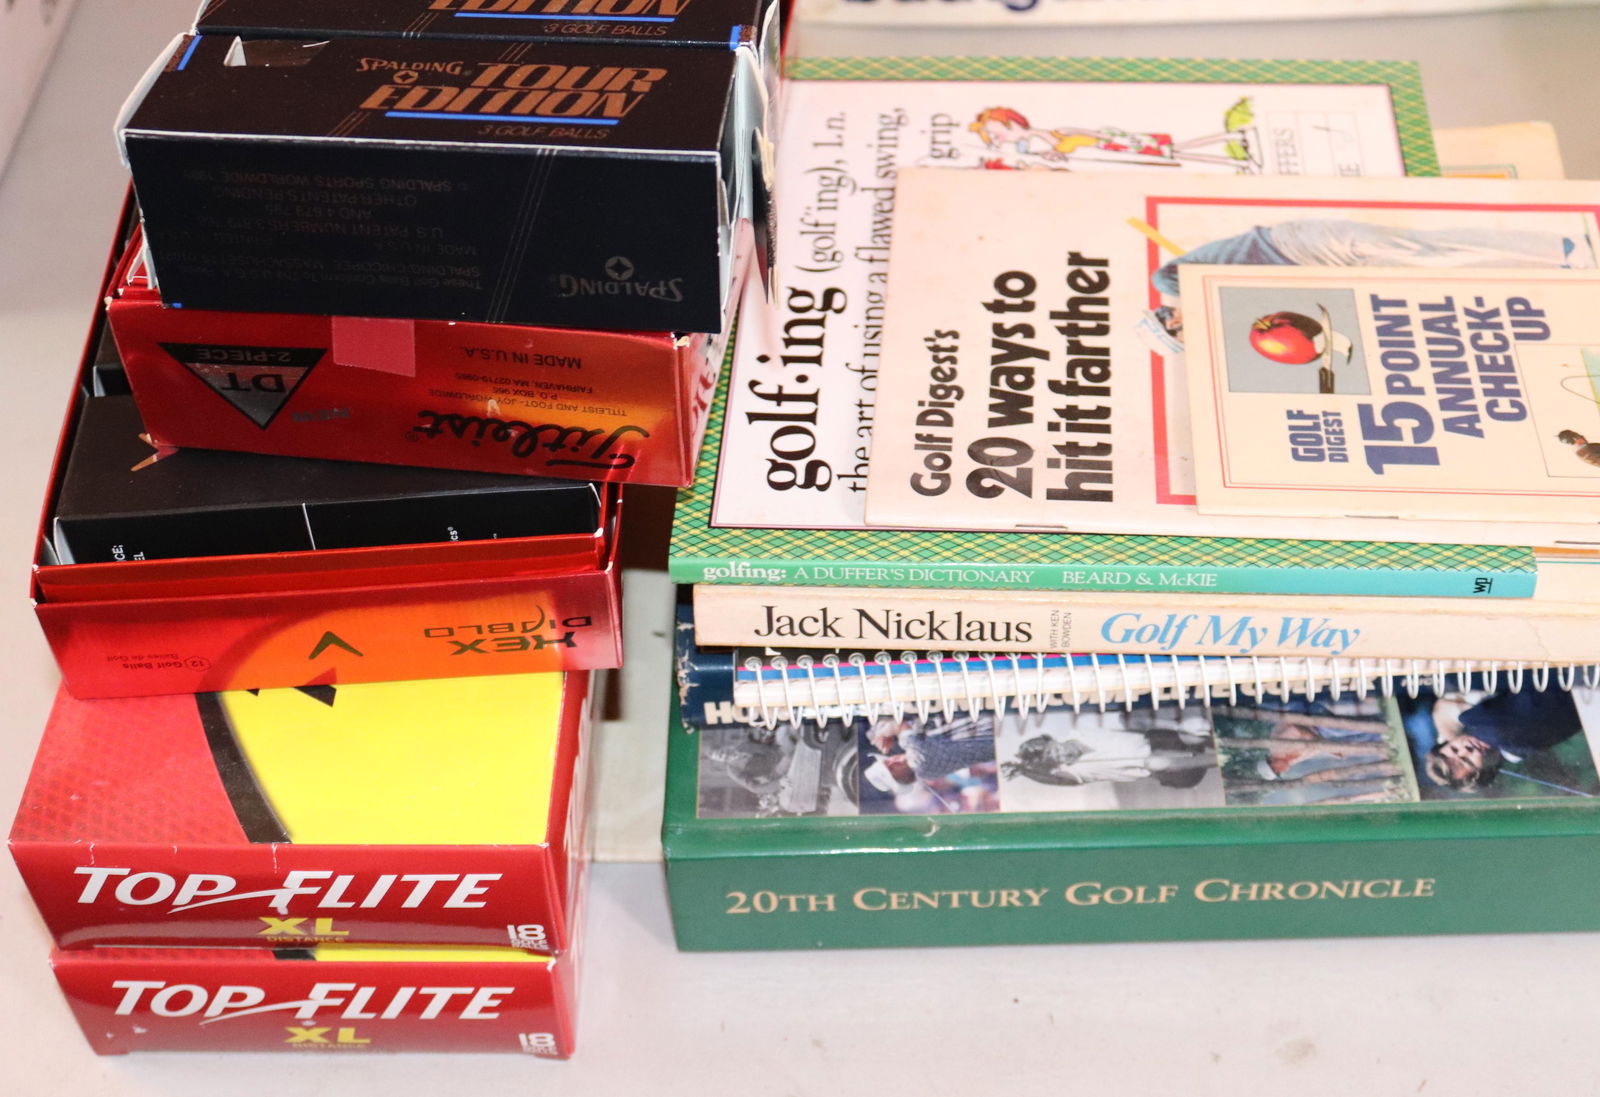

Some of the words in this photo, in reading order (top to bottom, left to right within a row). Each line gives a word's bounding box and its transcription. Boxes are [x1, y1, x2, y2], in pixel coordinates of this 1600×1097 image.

[544, 23, 559, 33] 3
[561, 23, 608, 34] GOLF
[610, 25, 669, 36] BALLS
[356, 57, 465, 76] SPALDING
[470, 62, 669, 92] TOUR
[358, 84, 646, 118] EDITION
[477, 125, 493, 135] 3
[494, 126, 548, 137] GOLF
[549, 127, 611, 139] BALLS
[867, 107, 910, 180] swing,
[920, 112, 961, 160] grip
[379, 177, 453, 192] SPALDING
[855, 187, 897, 263] flawed
[558, 274, 683, 302] SPALDING
[980, 270, 1037, 314] to
[1047, 250, 1112, 397] farther
[1505, 296, 1552, 342] UP
[199, 349, 292, 363] 2-PIECE
[463, 346, 508, 362] U.S.A.
[512, 353, 529, 364] IN
[1369, 293, 1426, 396] POINT
[1462, 296, 1528, 423] CHECK-
[534, 353, 583, 370] MADE
[987, 321, 1051, 428] ways
[1418, 295, 1486, 439] ANNUAL
[220, 372, 287, 394] DT
[515, 377, 532, 388] MA
[534, 379, 593, 394] FAIRHAVEN,
[845, 362, 880, 392] of
[916, 329, 965, 428] Digest's
[513, 389, 535, 399] BOX
[555, 403, 579, 413] AND
[583, 405, 628, 417] TITLEIST
[854, 399, 875, 438] art
[1047, 404, 1112, 434] it
[413, 410, 650, 470] Titleist
[1286, 409, 1327, 463] GOLF
[1321, 410, 1350, 463] DIGEST
[1356, 401, 1441, 475] 15
[837, 445, 869, 493] the
[910, 432, 953, 497] Golf
[965, 436, 1036, 499] 20
[1045, 441, 1114, 503] hit
[703, 562, 788, 582] golfing:
[793, 567, 811, 580] A
[813, 566, 906, 581] DUFFER'S
[909, 568, 1036, 585] DICTIONARY
[1062, 571, 1132, 586] BEARD
[1134, 572, 1154, 586] &
[1158, 573, 1218, 588] McKIE
[424, 604, 592, 639] DIABLO
[754, 604, 846, 640] Jack
[854, 607, 1034, 643] Nicklaus
[1050, 609, 1060, 628] KEN
[1061, 612, 1072, 649] BOWDEN
[1100, 610, 1198, 651] Golf
[1198, 614, 1269, 653] My
[1277, 617, 1361, 655] Way
[448, 631, 577, 656] HEX
[1050, 629, 1059, 649] WITH
[122, 662, 153, 670] Balls
[157, 661, 185, 670] Golf
[73, 866, 237, 912] TOP
[268, 870, 504, 910] FLITE
[725, 889, 838, 914] 20TH
[256, 916, 350, 936] XL
[507, 924, 547, 940] 18
[111, 980, 266, 1023] TOP
[295, 982, 515, 1020] FLITE
[284, 1027, 373, 1044] XL
[518, 1032, 557, 1047] 18
